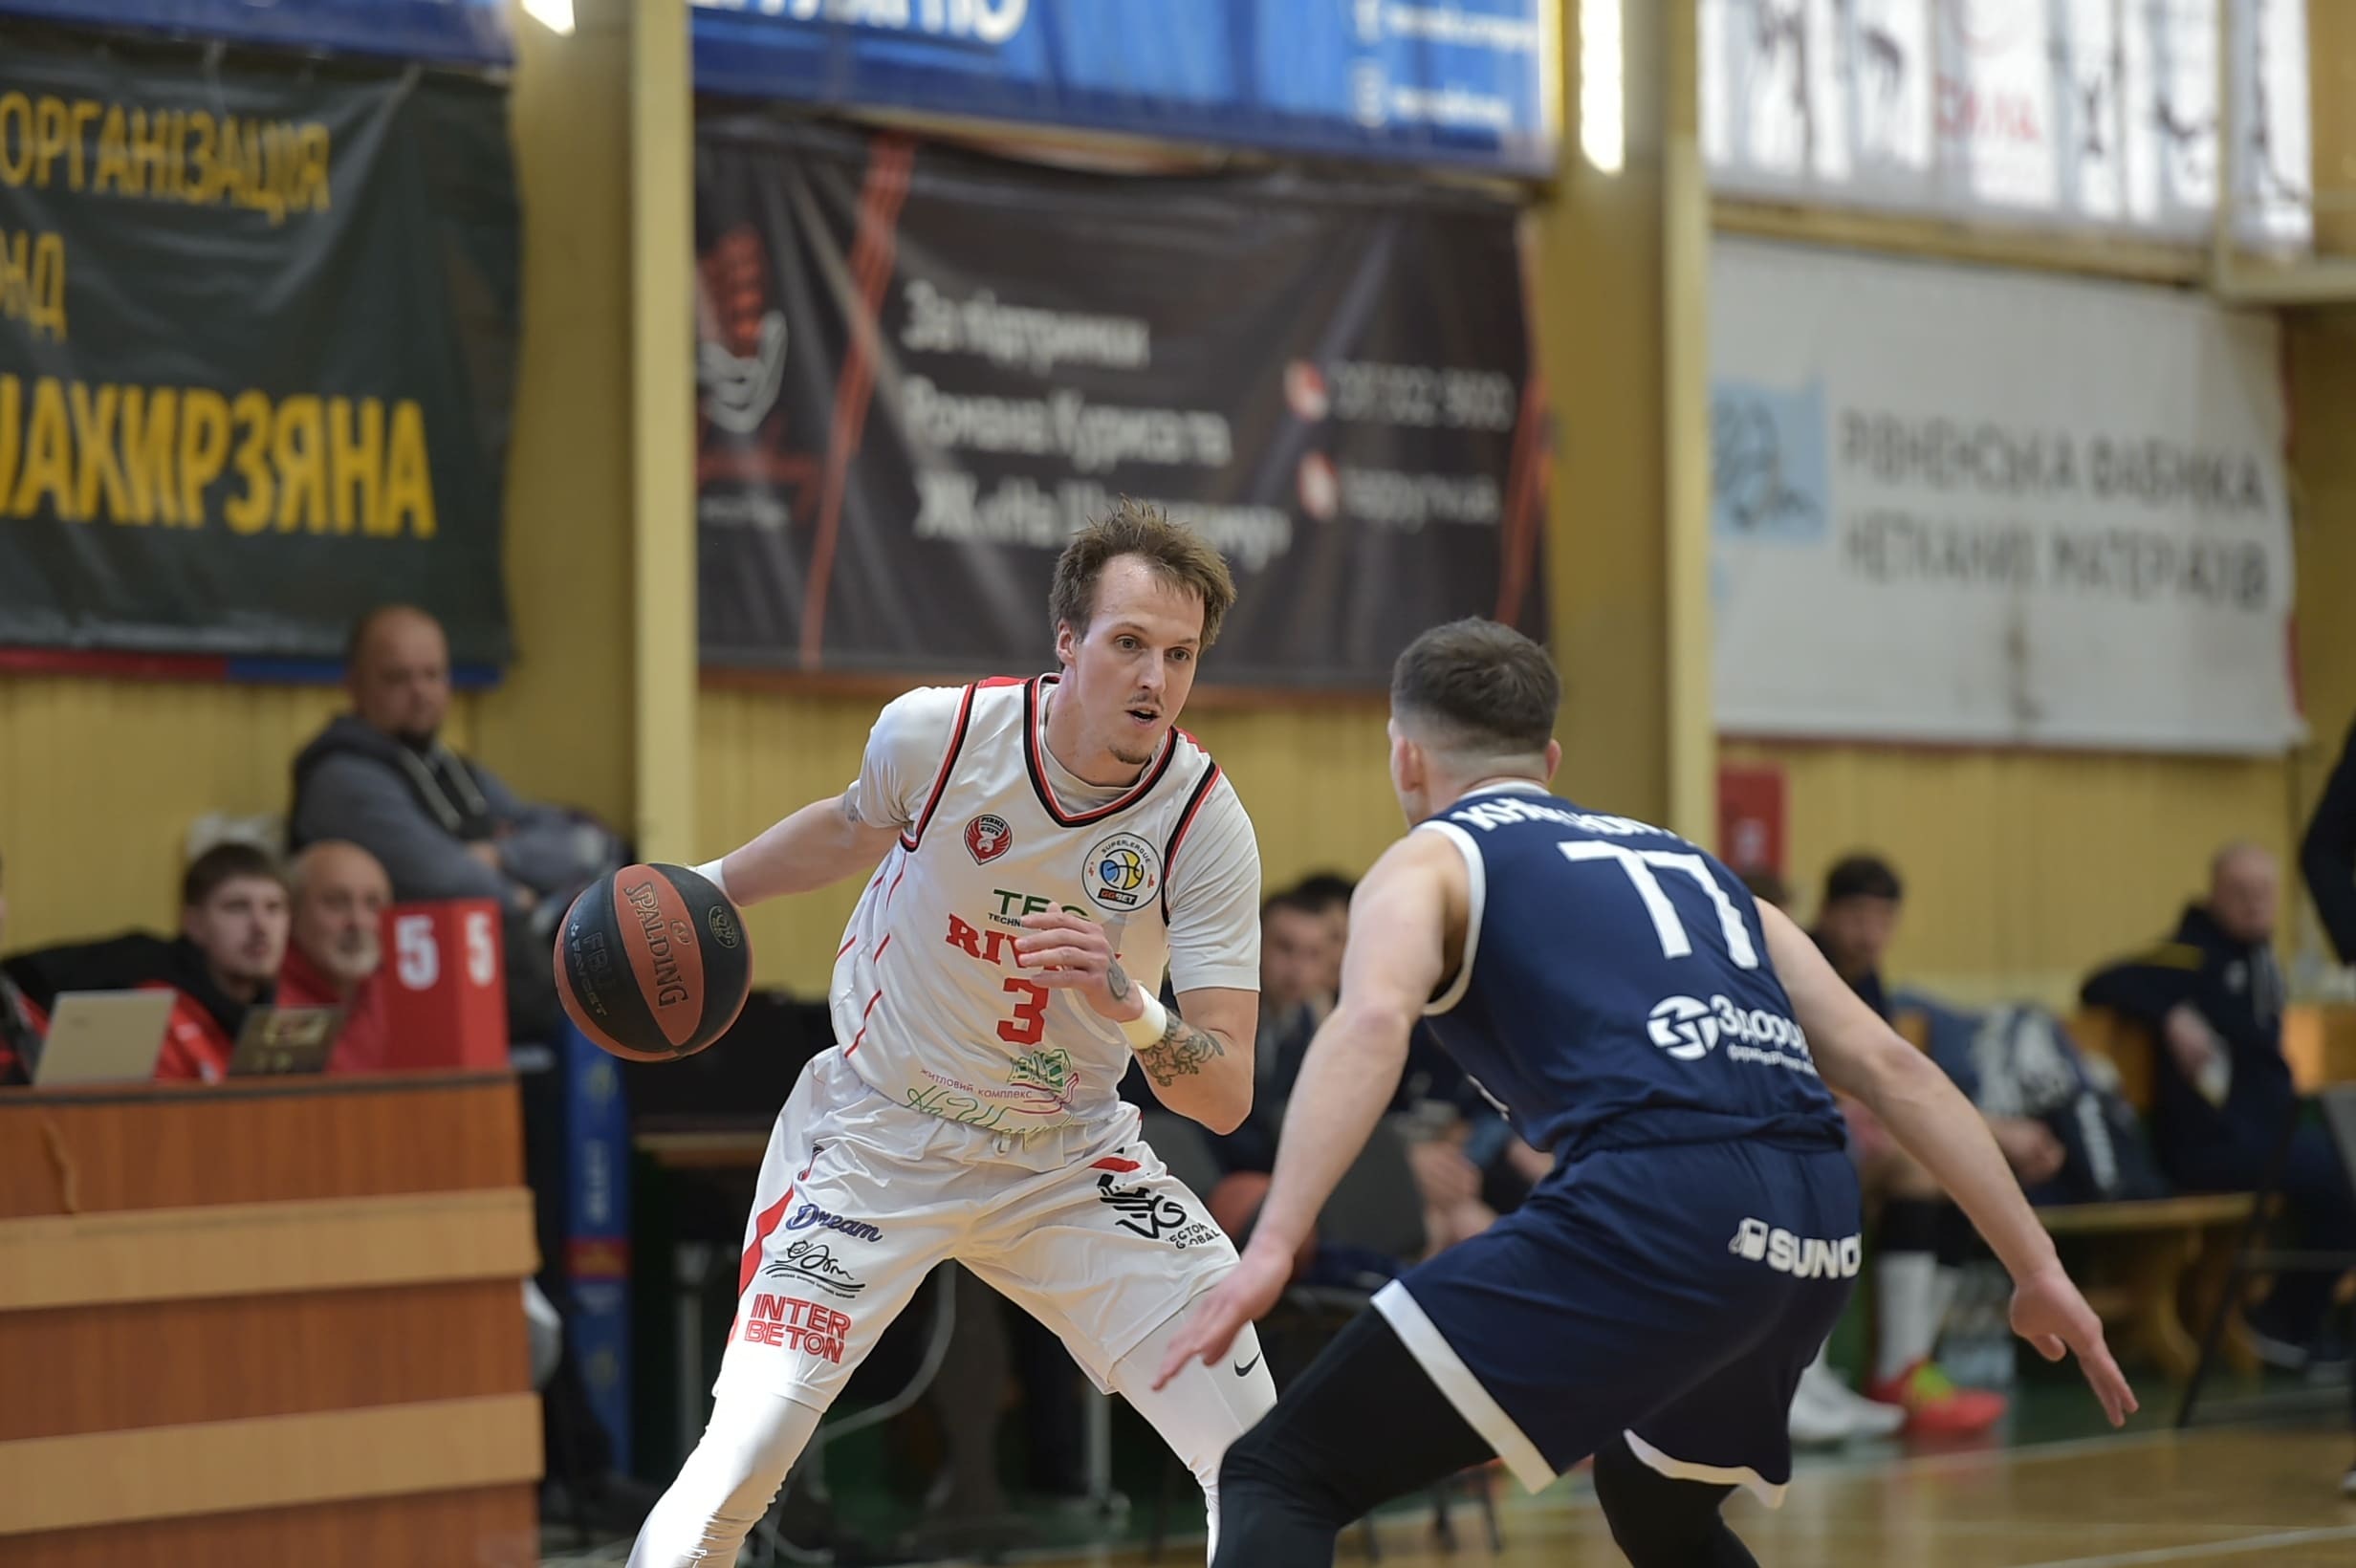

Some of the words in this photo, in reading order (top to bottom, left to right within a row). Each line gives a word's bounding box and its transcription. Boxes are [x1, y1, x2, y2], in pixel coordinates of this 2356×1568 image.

[1558, 840, 1759, 969] 77
[394, 913, 440, 990] 5
[465, 910, 495, 988] 5
[623, 881, 689, 1008] SPALDING
[997, 977, 1050, 1045] 3
[921, 1068, 975, 1092] житловий
[977, 1088, 1033, 1100] комплекс
[786, 1203, 884, 1243] Dream
[1166, 1222, 1209, 1243] ECTOR
[1175, 1229, 1221, 1250] GOBAL
[1767, 1228, 1862, 1279] SUNO
[751, 1294, 852, 1340] INTER
[745, 1319, 844, 1364] BETON
